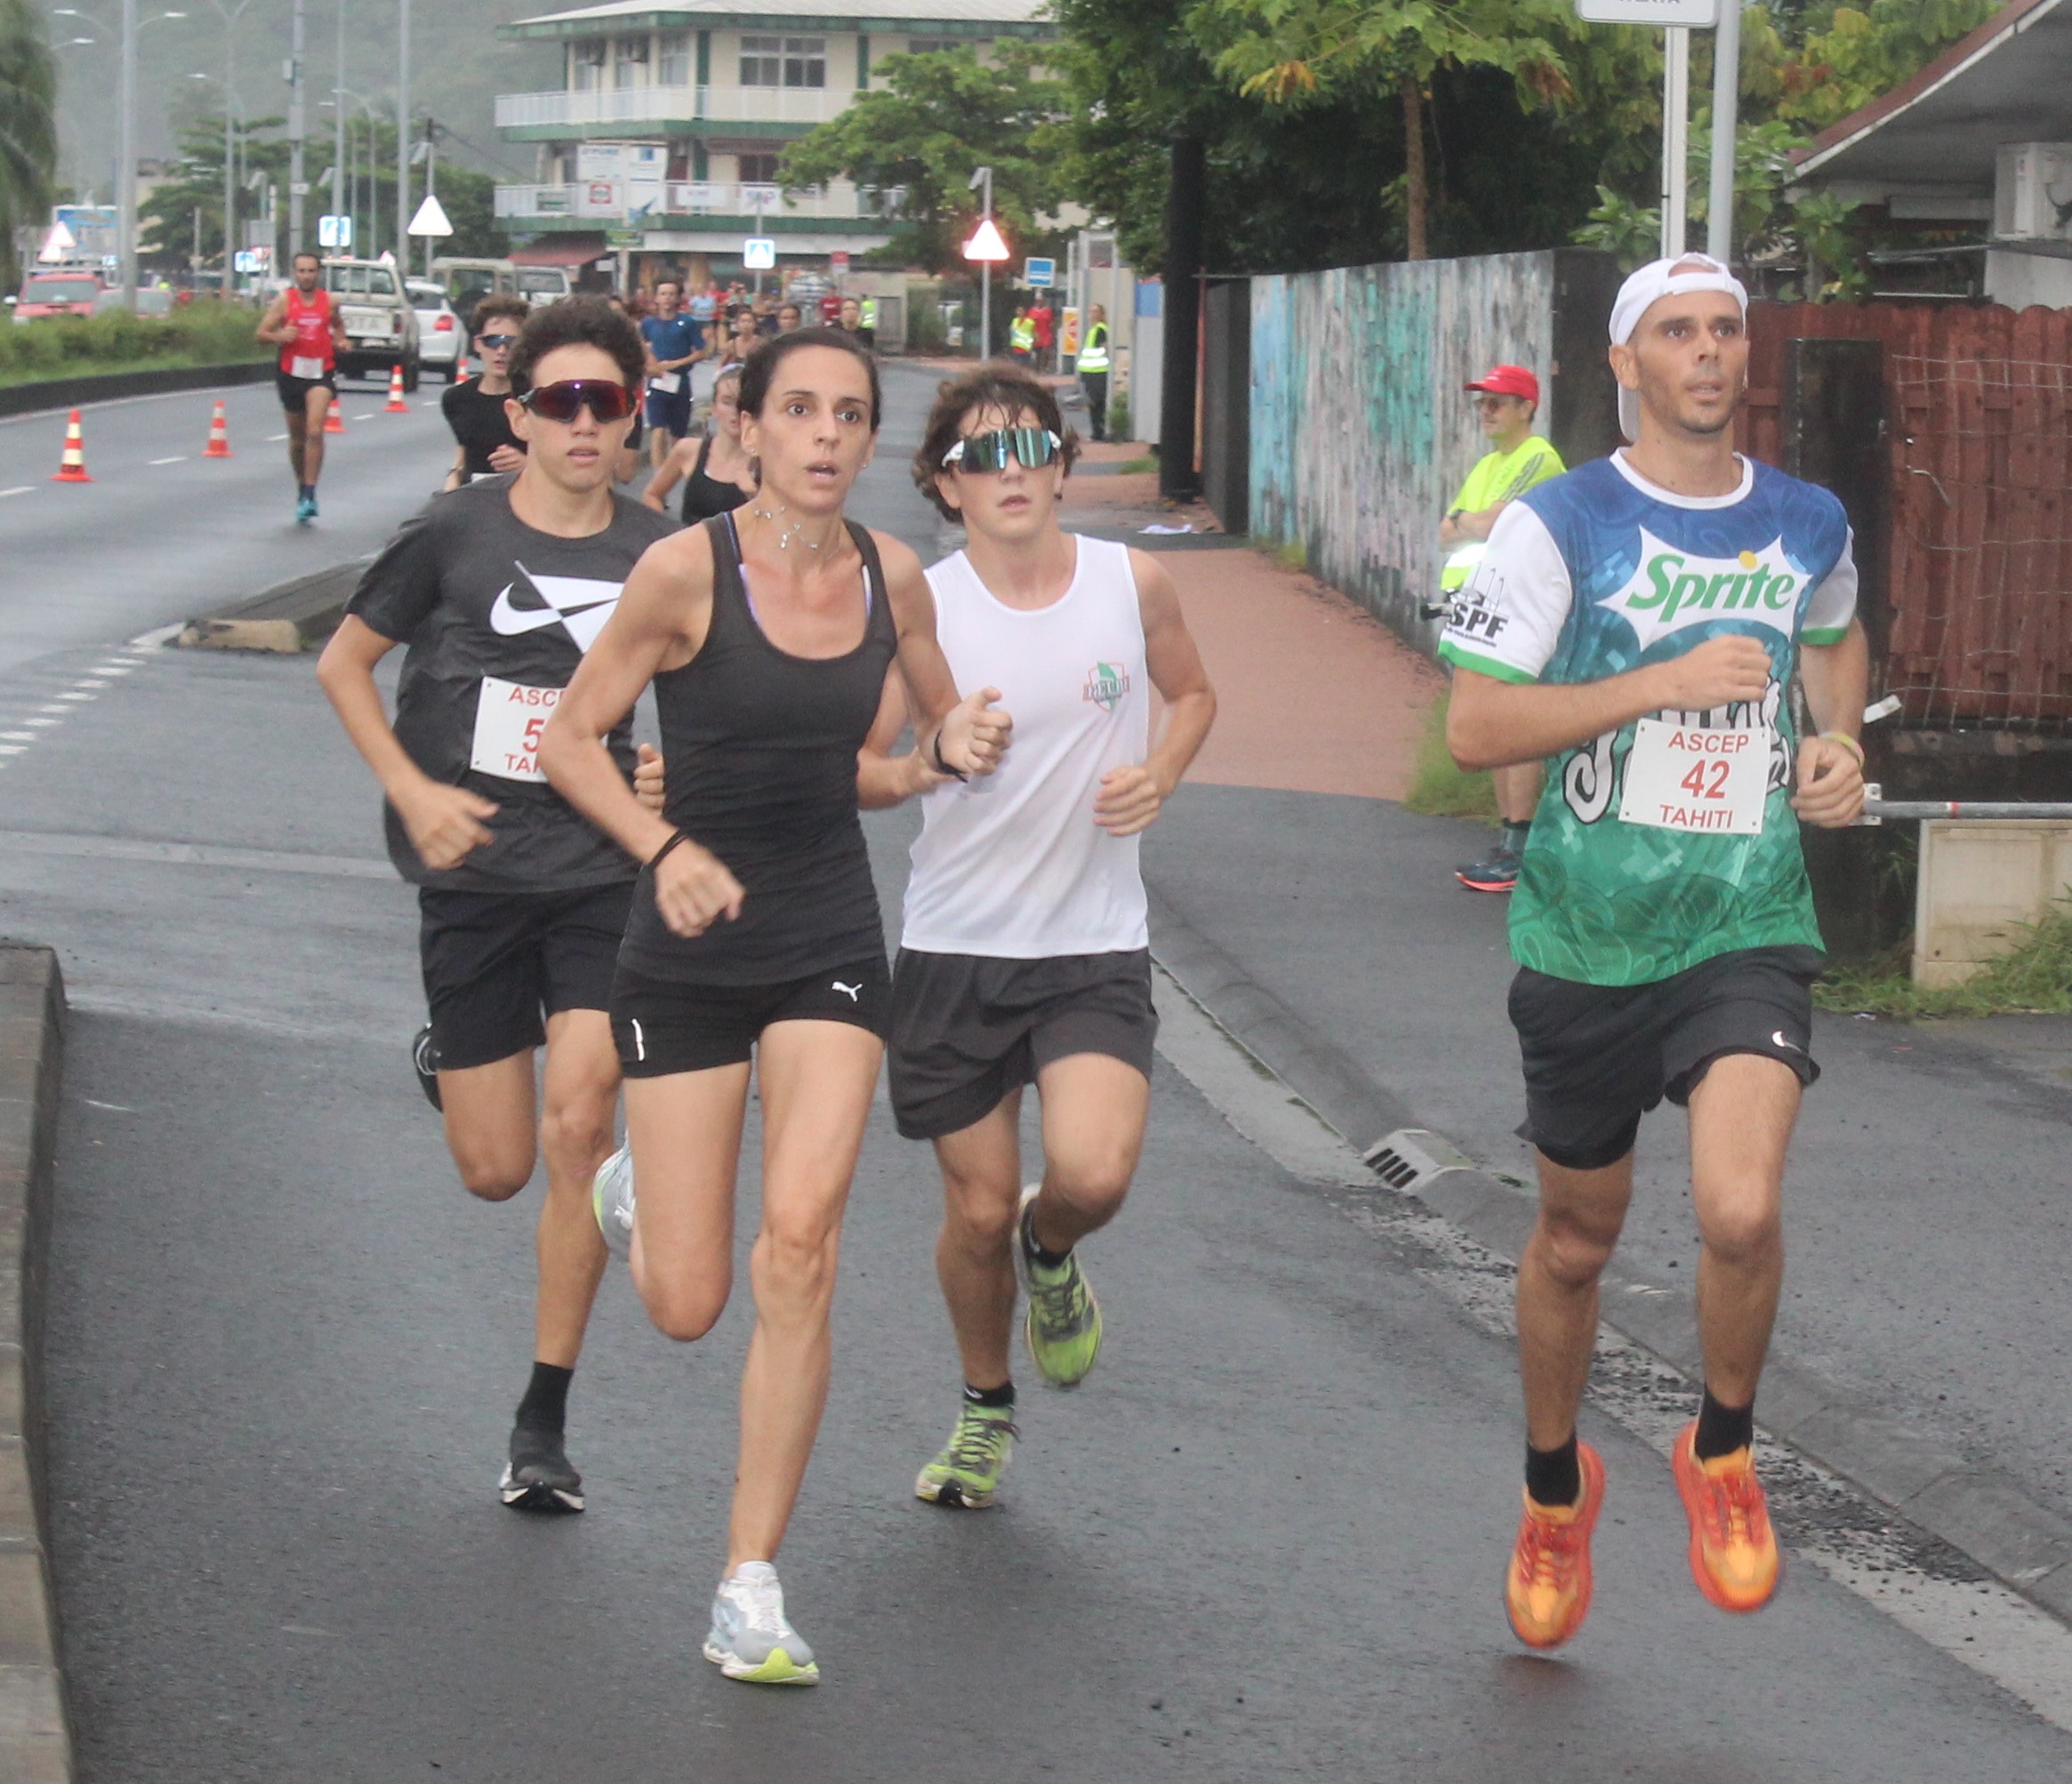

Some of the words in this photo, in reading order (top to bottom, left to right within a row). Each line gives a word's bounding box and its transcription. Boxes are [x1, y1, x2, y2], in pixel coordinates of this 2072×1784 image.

[1625, 550, 1795, 623] Sprite
[1449, 603, 1509, 639] SPF
[1668, 731, 1750, 753] ASCEP
[1681, 759, 1731, 800] 42
[1659, 804, 1733, 829] TAHITI
